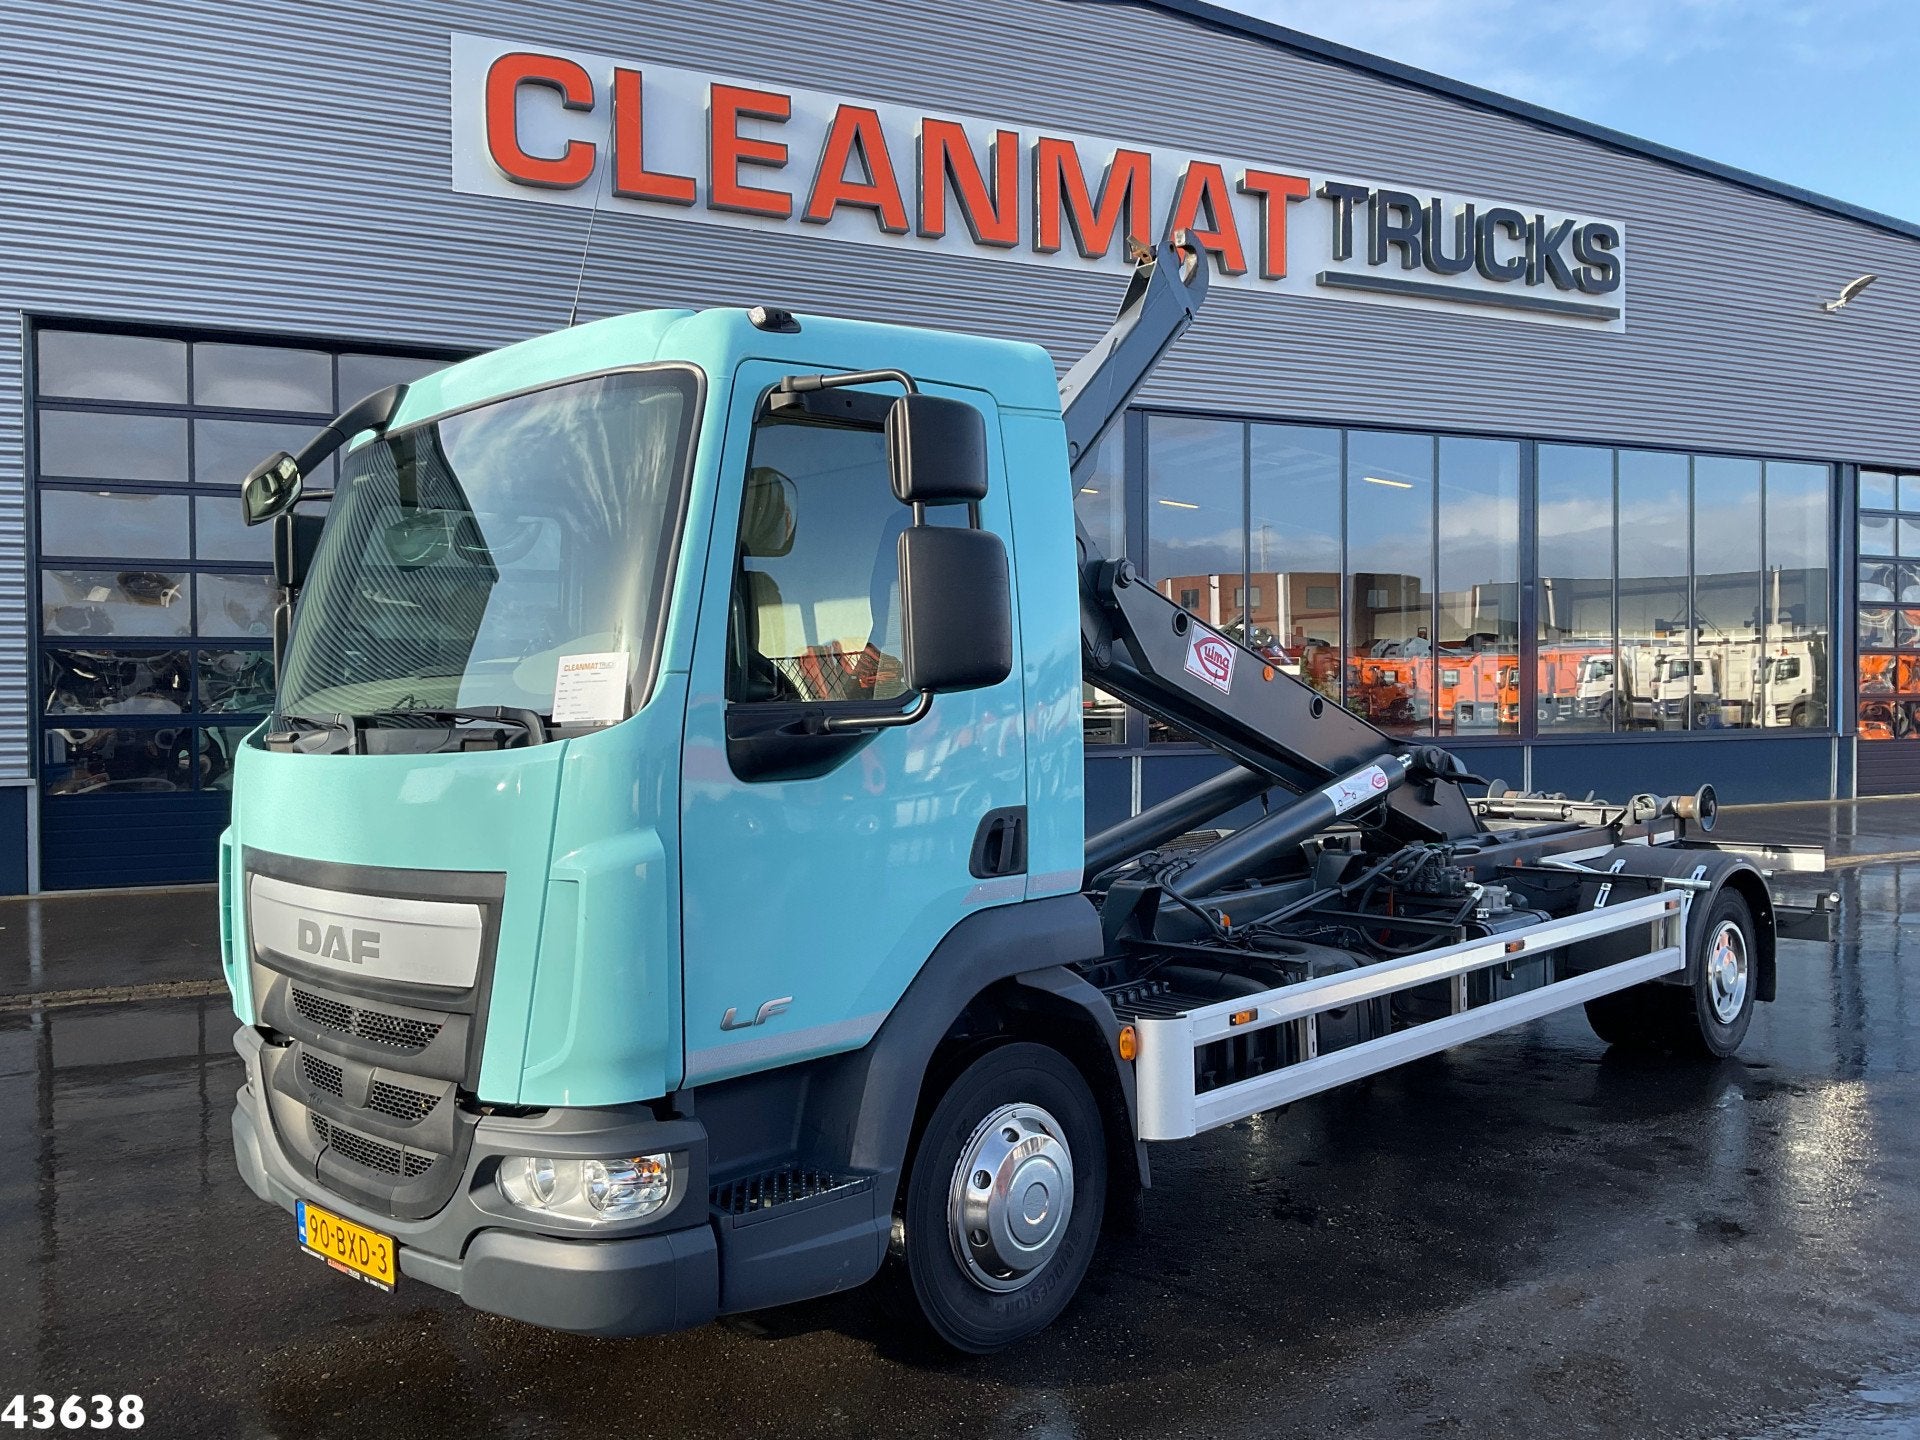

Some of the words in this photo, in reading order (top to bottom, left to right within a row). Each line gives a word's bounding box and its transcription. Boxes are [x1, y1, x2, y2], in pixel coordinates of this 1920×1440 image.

[485, 51, 1311, 280] CLEANMAT
[1317, 180, 1621, 295] TRUCKS
[298, 918, 381, 965] DAF
[720, 995, 793, 1031] LF
[309, 1214, 387, 1275] 90-BXD-3
